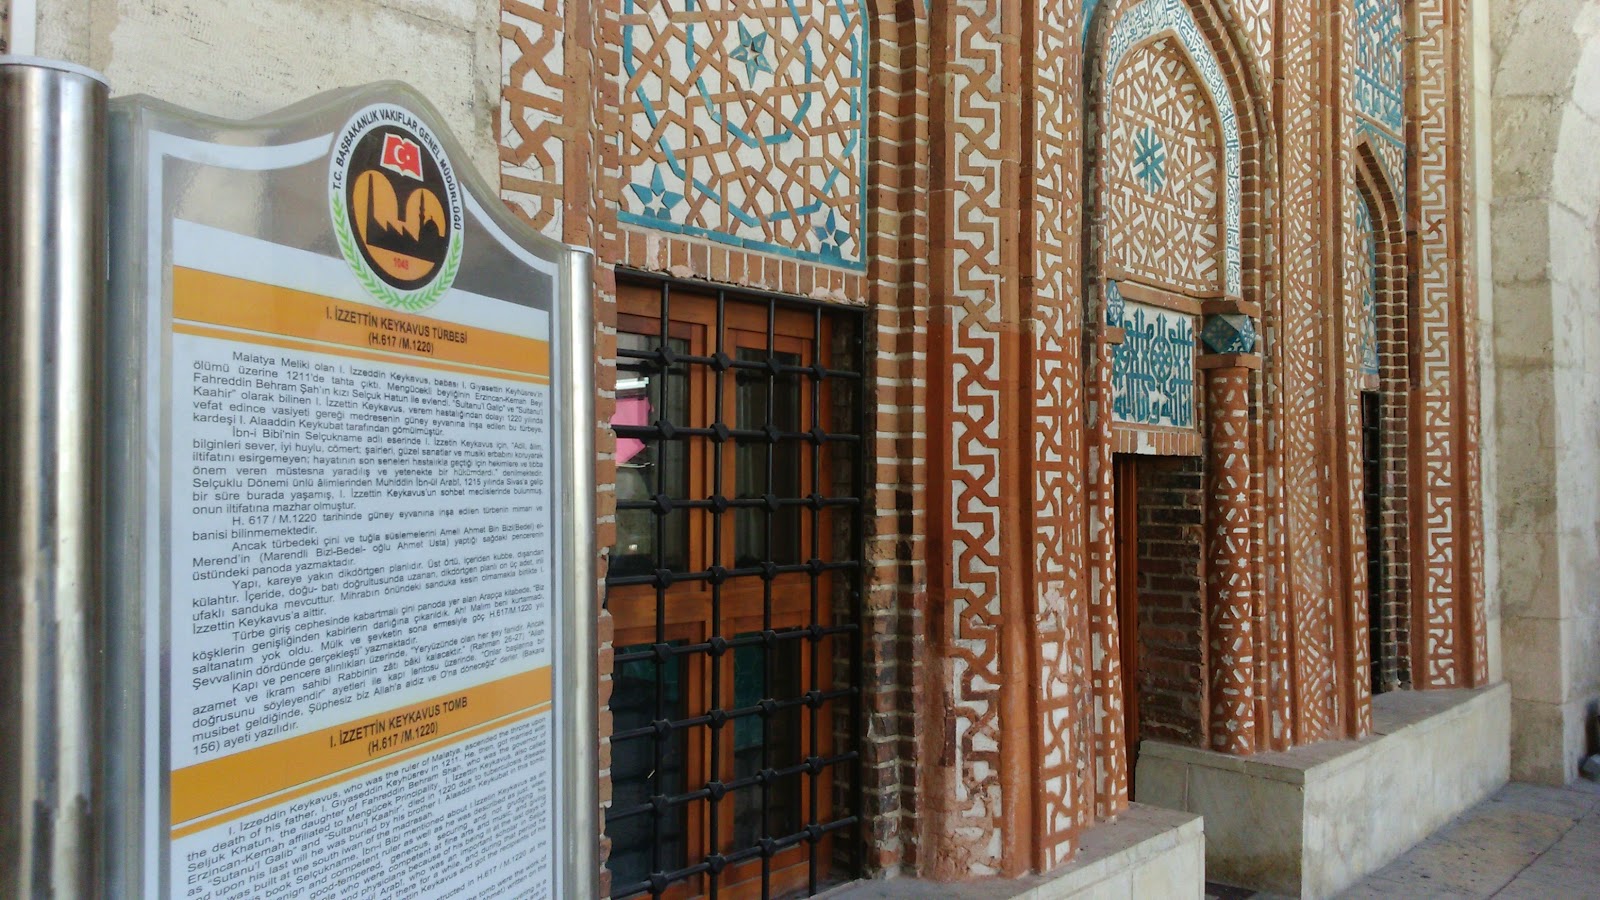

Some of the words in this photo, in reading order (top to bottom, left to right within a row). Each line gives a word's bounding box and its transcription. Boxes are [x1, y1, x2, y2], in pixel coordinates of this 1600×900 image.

[379, 109, 418, 133] VAKIFLAR
[335, 109, 380, 166] BAŞBAKANLIK
[418, 126, 440, 160] GENEL
[333, 170, 343, 190] T.C.
[439, 158, 462, 231] MÜDÜRLÜĞÜ
[326, 306, 333, 320] I.
[335, 305, 378, 328] İZZETTİN
[380, 317, 430, 338] KEYKAVUS
[432, 327, 468, 345] TÜRBESİ
[368, 332, 397, 346] (H.617
[398, 337, 434, 355] /M.1220)
[193, 360, 229, 372] ölümü
[238, 365, 278, 378] üzerine
[232, 351, 275, 366] Malatya
[281, 357, 309, 369] Meliki
[314, 363, 335, 372] olan
[193, 372, 251, 387] Fahreddin
[256, 378, 296, 391] Behram
[240, 390, 274, 402] olarak
[278, 393, 311, 404] bilinen
[193, 400, 222, 410] vefat
[229, 403, 265, 413] edince
[272, 406, 309, 417] vasiyeti
[315, 410, 344, 421] gereği
[193, 412, 235, 426] kardeşi
[249, 416, 295, 427] Alaaddin
[298, 419, 343, 430] Keykubat
[192, 451, 234, 461] iltifatını
[193, 438, 241, 451] bilginleri
[280, 441, 291, 453] iyi
[192, 465, 226, 475] önem
[276, 467, 324, 475] müstesna
[192, 477, 242, 490] Selçuklu
[247, 478, 288, 487] Dönemi
[292, 478, 313, 487] ünlü
[192, 491, 208, 501] bir
[214, 491, 240, 500] süre
[246, 490, 284, 500] burada
[192, 506, 222, 514] onun
[226, 503, 269, 513] iltifatına
[272, 502, 311, 511] mazhar
[232, 516, 244, 526] H.
[248, 515, 269, 525] 617
[279, 513, 316, 523] M.1220
[192, 529, 227, 541] banisi
[231, 540, 266, 551] Ancak
[272, 537, 318, 548] türbedeki
[323, 536, 339, 547] çini
[259, 549, 308, 563] (Marendli
[192, 566, 249, 580] üstündeki
[252, 563, 291, 577] panoda
[267, 575, 302, 586] kareye
[192, 608, 224, 621] ufaklı
[231, 602, 278, 616] sanduka
[193, 620, 234, 634] İzzettin
[232, 629, 264, 641] Türbe
[269, 624, 290, 638] giriş
[294, 615, 349, 631] cephesinde
[192, 645, 244, 661] köşklerin
[252, 633, 319, 653] genişliğinden
[192, 656, 253, 674] saltanatım
[261, 648, 281, 664] yok
[320, 639, 343, 650] Mülk
[192, 669, 252, 690] Şevvalinin
[256, 658, 306, 675] dördünde
[232, 681, 258, 693] Kapı
[262, 677, 275, 686] ve
[280, 668, 320, 685] pencere
[192, 697, 236, 715] azamet
[244, 694, 258, 703] ve
[266, 686, 295, 698] ikram
[302, 676, 331, 690] sahibi
[192, 707, 254, 728] doğrusunu
[330, 735, 337, 748] I.
[340, 719, 386, 746] İZZETTİN
[388, 706, 440, 729] KEYKAVUS
[443, 696, 468, 717] TOMB
[192, 722, 240, 742] musibet
[368, 733, 398, 757] (H.617
[400, 721, 438, 744] /M.1220)
[193, 740, 220, 755] 156)
[223, 731, 250, 748] ayeti
[240, 810, 286, 831] İzzeddin
[187, 853, 225, 872] Seljuk
[279, 827, 296, 838] the
[301, 804, 346, 830] daughter
[348, 802, 357, 812] of
[187, 849, 207, 861] the
[211, 835, 245, 852] death
[249, 827, 261, 838] of
[265, 822, 281, 833] his
[288, 822, 330, 845] affiliated
[333, 819, 343, 828] to
[187, 885, 203, 896] as
[301, 837, 320, 851] and
[215, 879, 245, 896] upon
[249, 871, 265, 883] his
[269, 861, 288, 874] last
[291, 852, 307, 865] will
[311, 847, 324, 857] he
[326, 838, 346, 850] was
[254, 876, 277, 892] built
[279, 871, 290, 881] at
[293, 864, 309, 875] the
[312, 851, 339, 867] south
[265, 881, 291, 898] book
[308, 874, 327, 889] and
